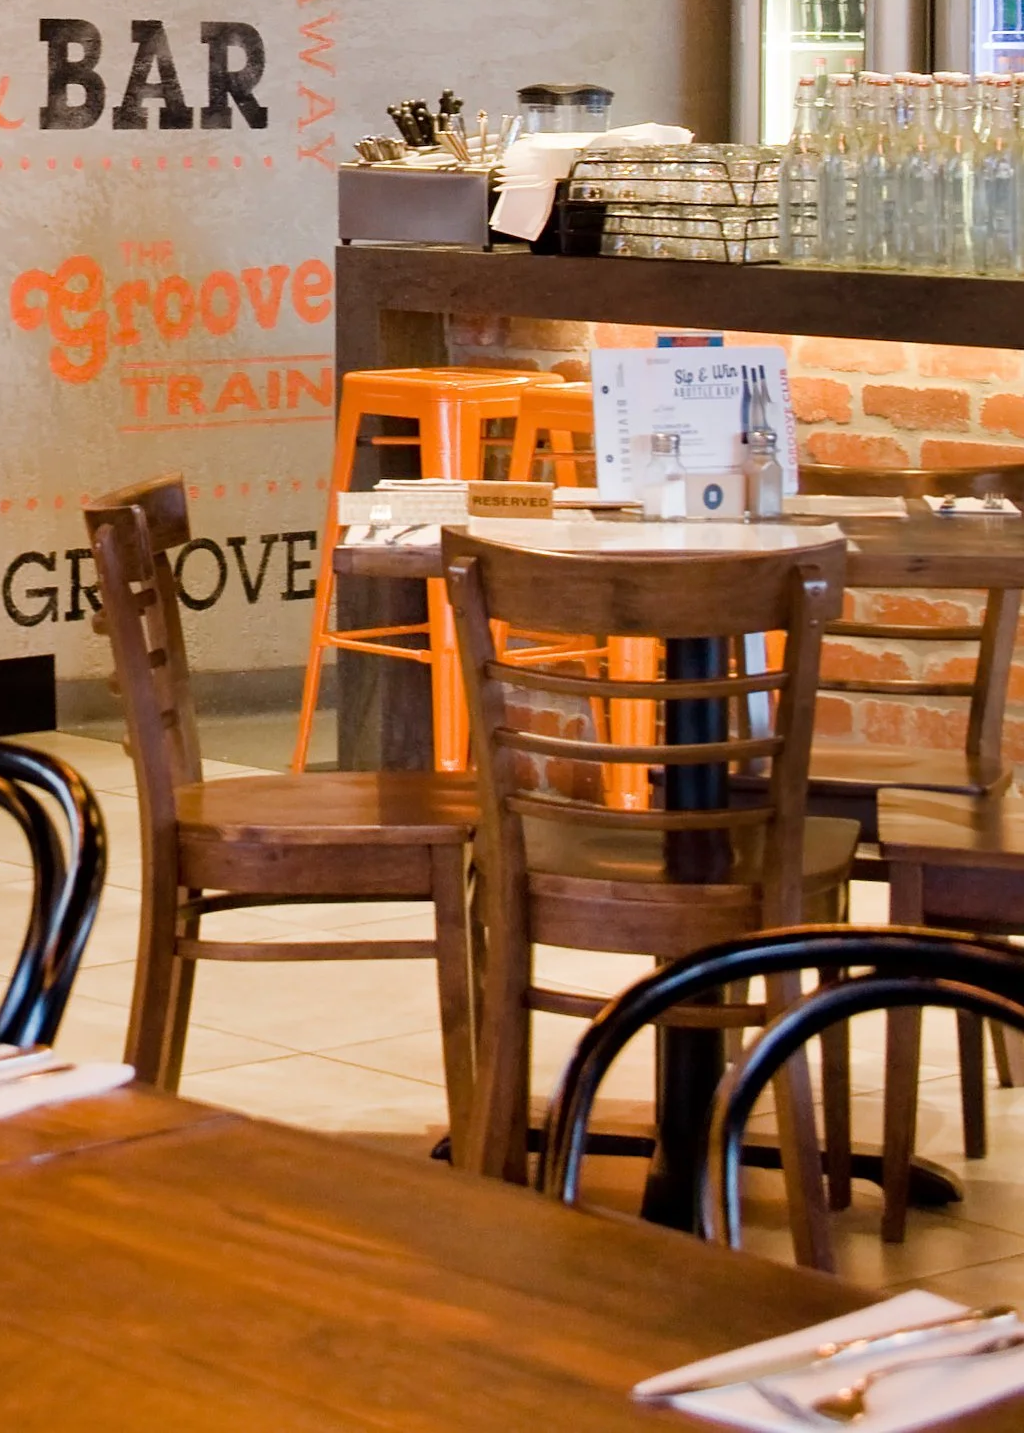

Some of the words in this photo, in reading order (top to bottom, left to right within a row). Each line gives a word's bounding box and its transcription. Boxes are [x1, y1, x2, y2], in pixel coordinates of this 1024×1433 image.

[39, 19, 268, 130] BAR
[119, 240, 174, 264] THE
[120, 366, 333, 417] TRAIN
[473, 495, 549, 508] RESERVED
[2, 530, 317, 628] GROVE
